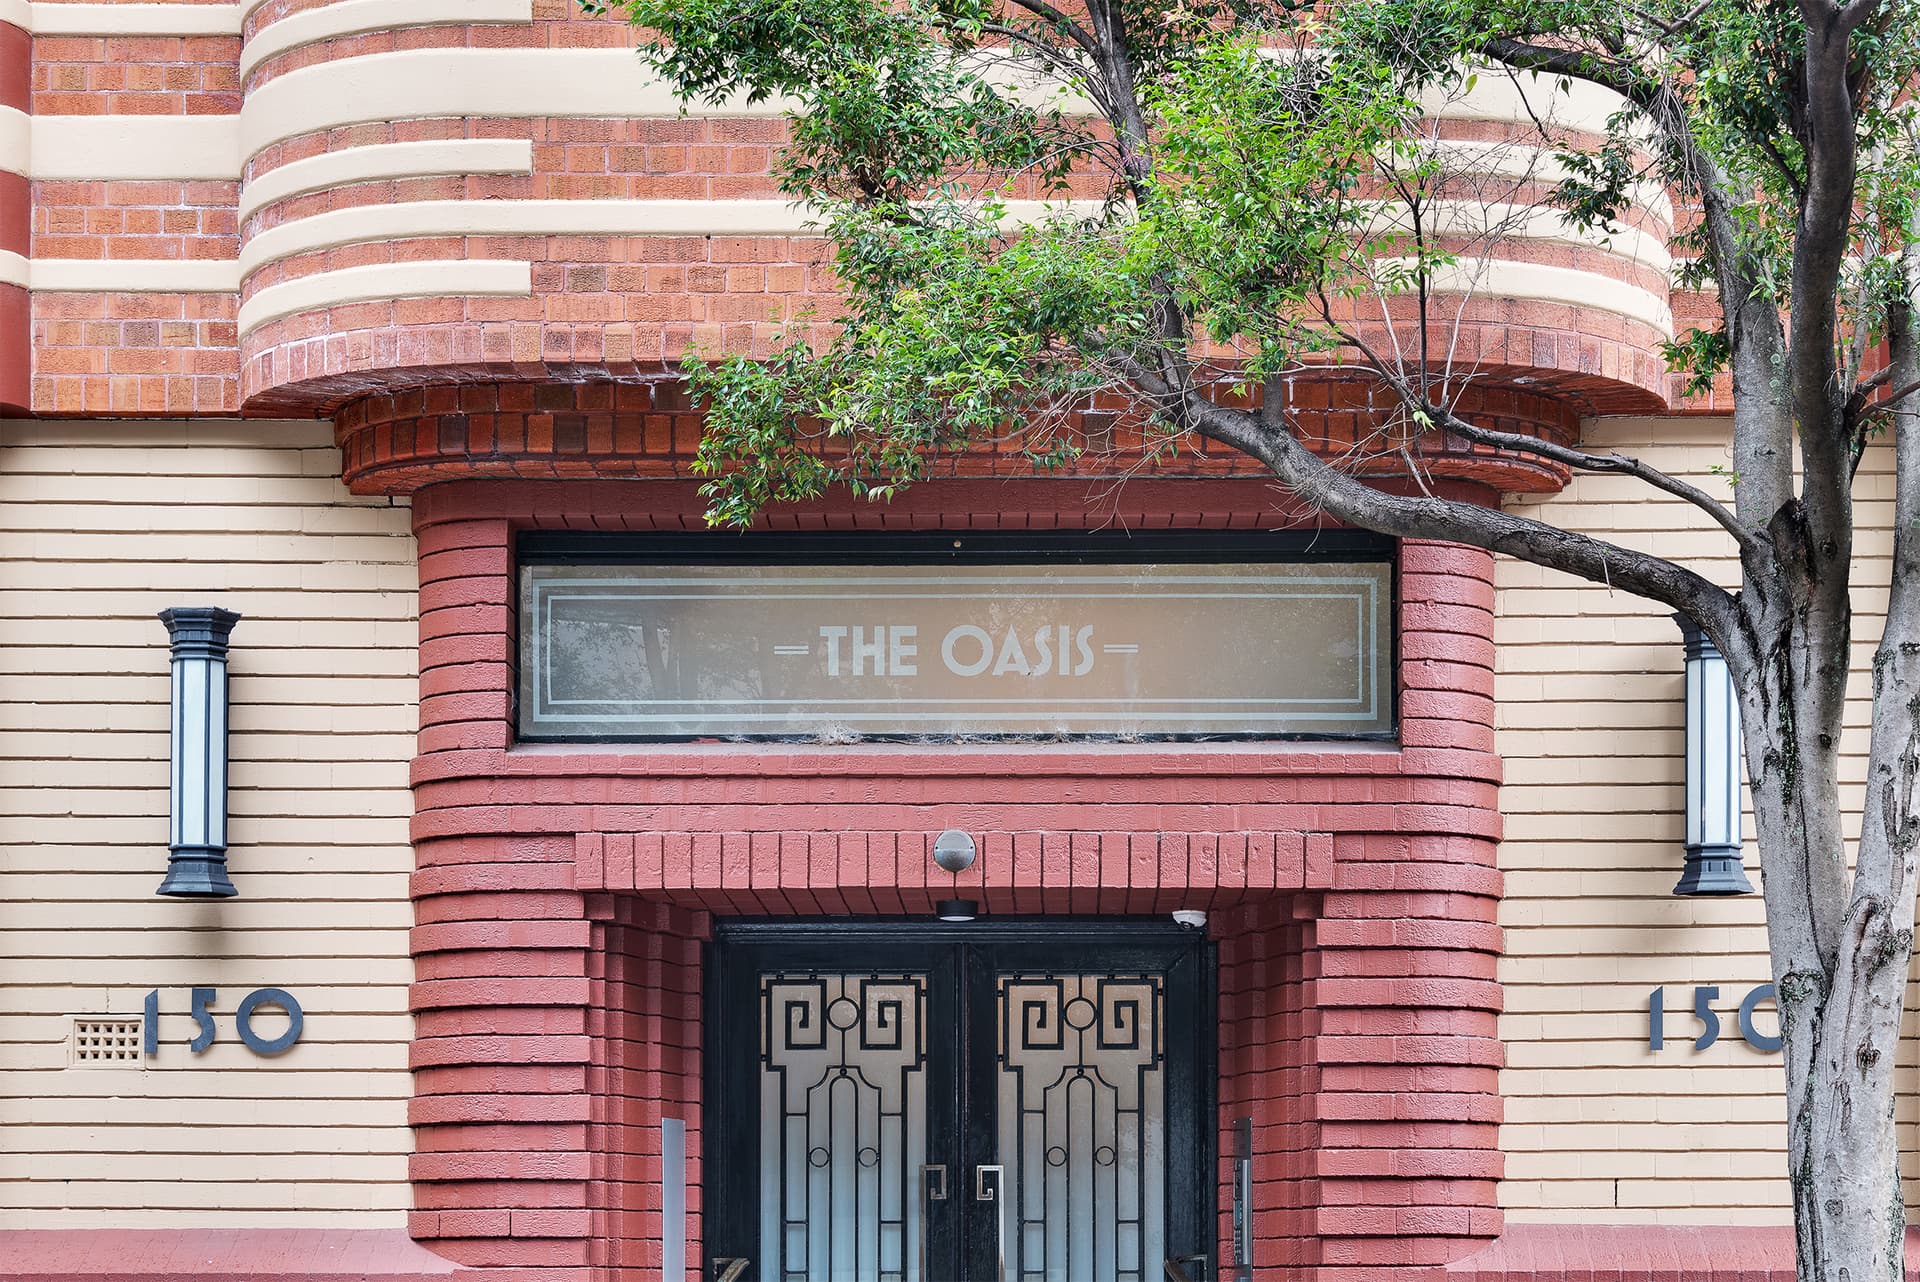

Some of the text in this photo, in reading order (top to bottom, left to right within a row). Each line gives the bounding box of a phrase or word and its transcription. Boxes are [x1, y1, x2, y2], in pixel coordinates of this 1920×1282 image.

[819, 624, 1095, 677] THE OASIS
[144, 988, 304, 1054] 150
